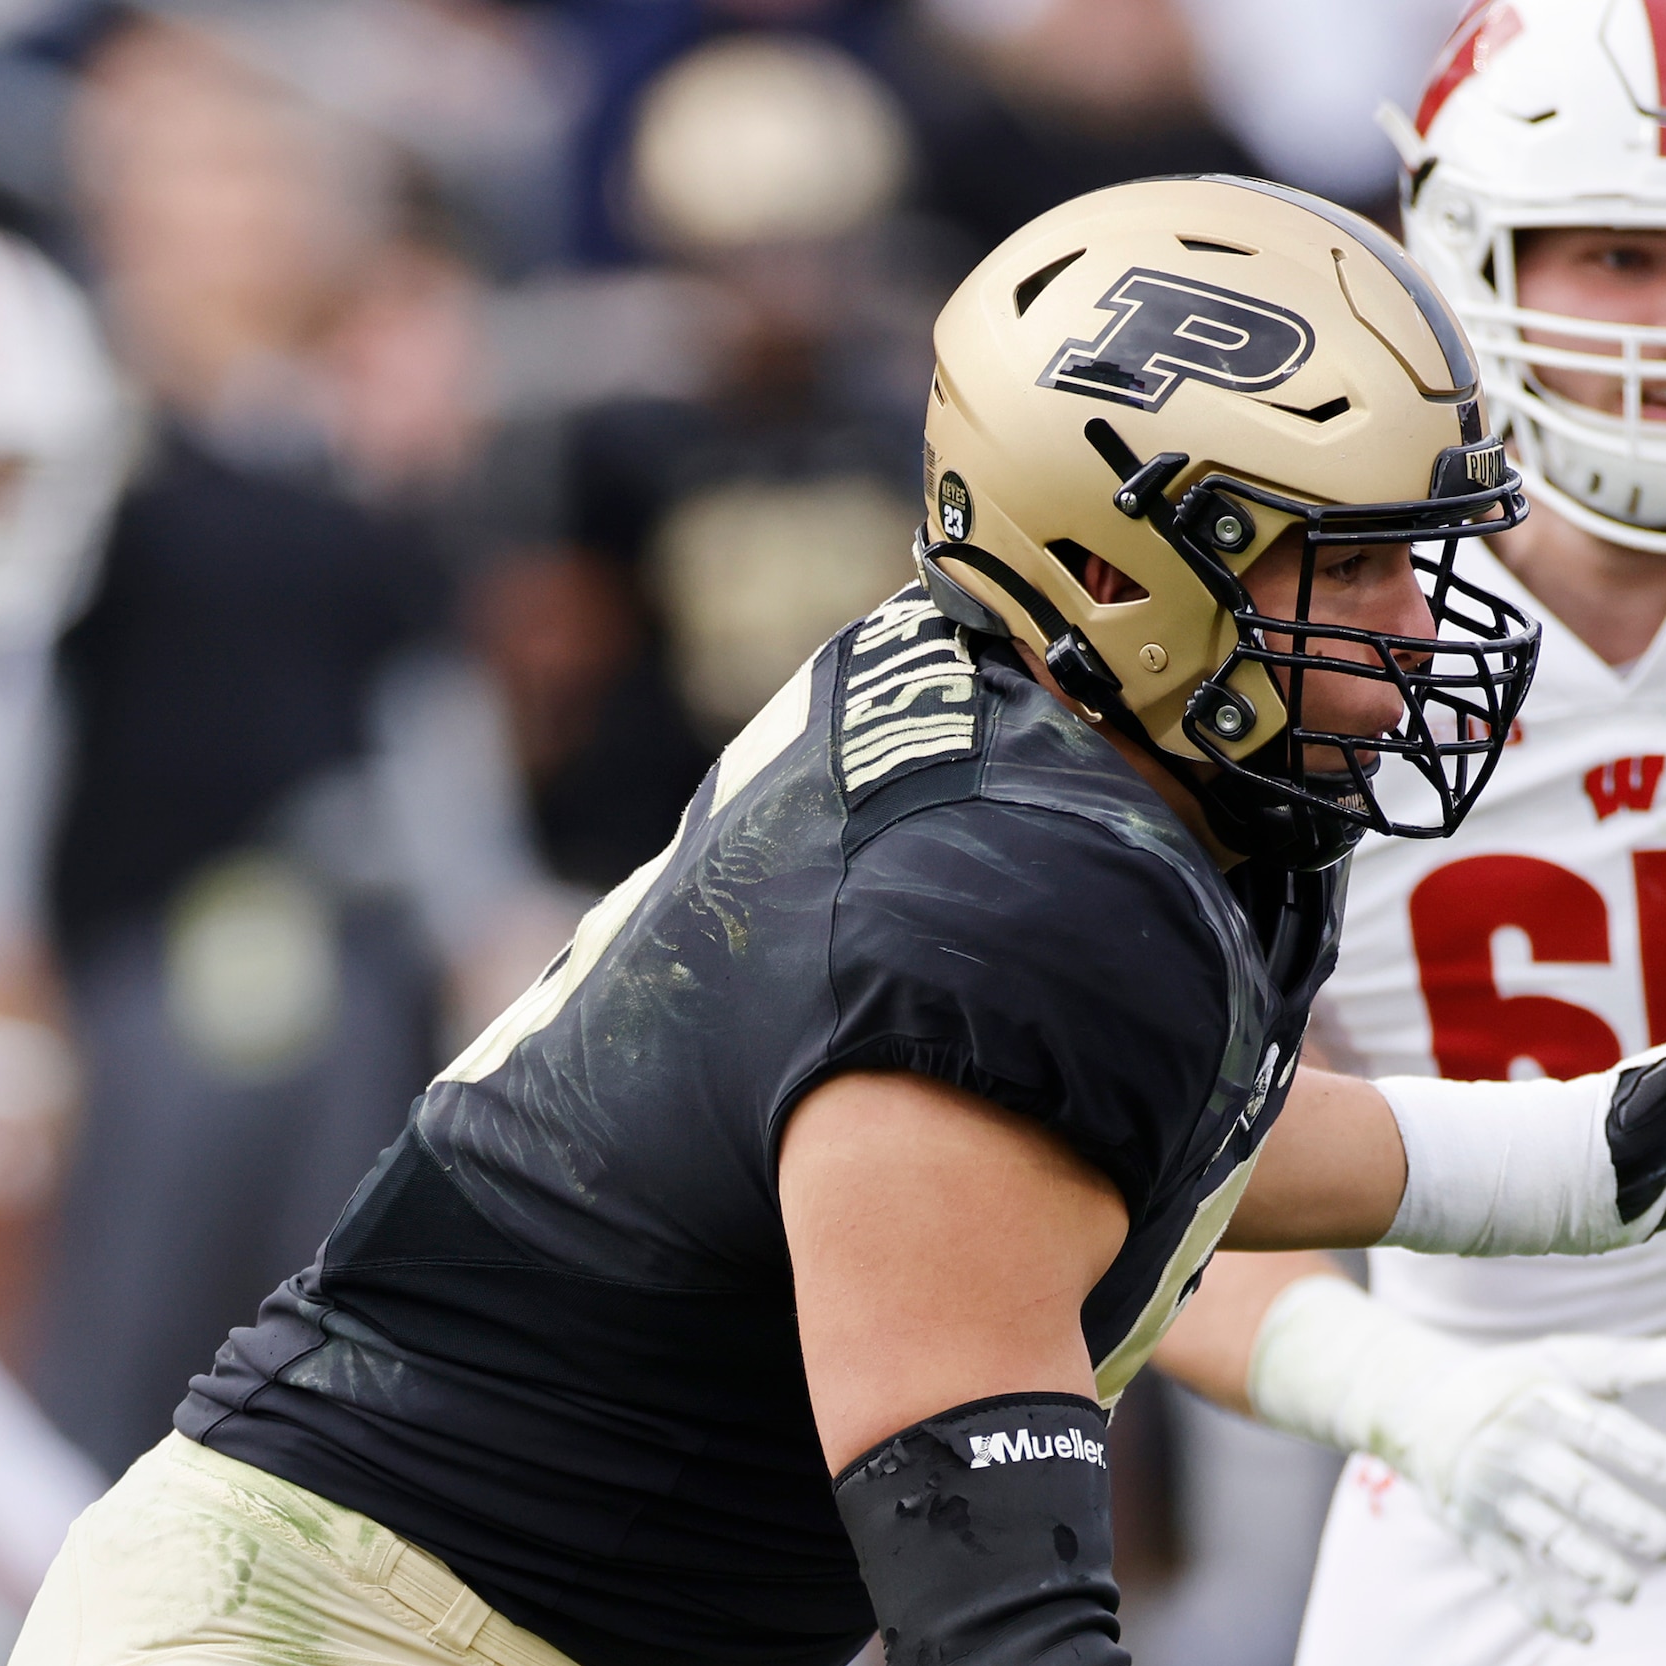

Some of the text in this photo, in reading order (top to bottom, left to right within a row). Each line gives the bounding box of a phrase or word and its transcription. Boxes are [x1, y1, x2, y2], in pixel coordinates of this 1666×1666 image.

[1036, 267, 1316, 413] P
[942, 480, 966, 504] KEYES
[944, 503, 964, 539] 23
[1583, 755, 1666, 821] W
[997, 1428, 1104, 1466] Mueller
